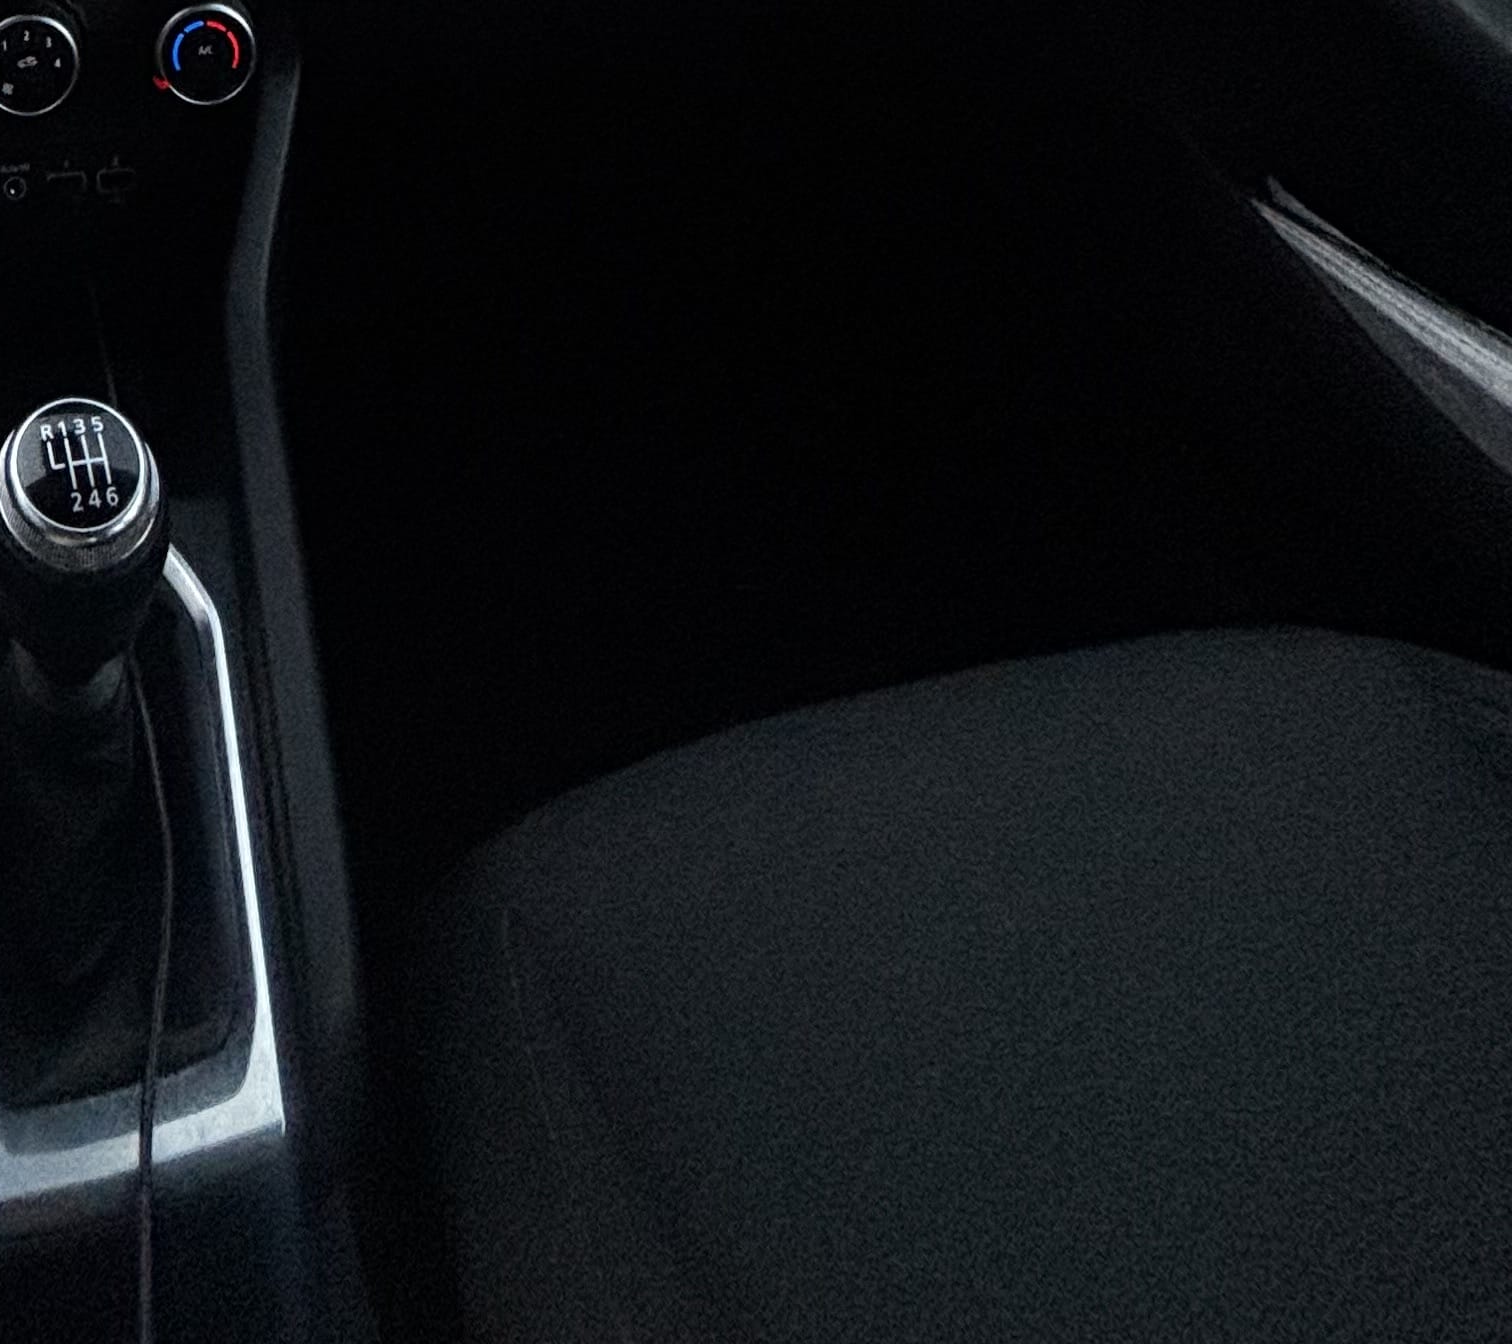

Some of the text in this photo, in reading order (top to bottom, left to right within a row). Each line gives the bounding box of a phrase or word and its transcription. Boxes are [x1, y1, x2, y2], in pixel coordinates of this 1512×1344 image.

[23, 29, 30, 42] 2
[1, 39, 7, 51] 1
[46, 36, 53, 48] 3
[54, 58, 62, 68] 4
[40, 416, 104, 441] R 1 3 5
[70, 487, 119, 512] 2 4 6
